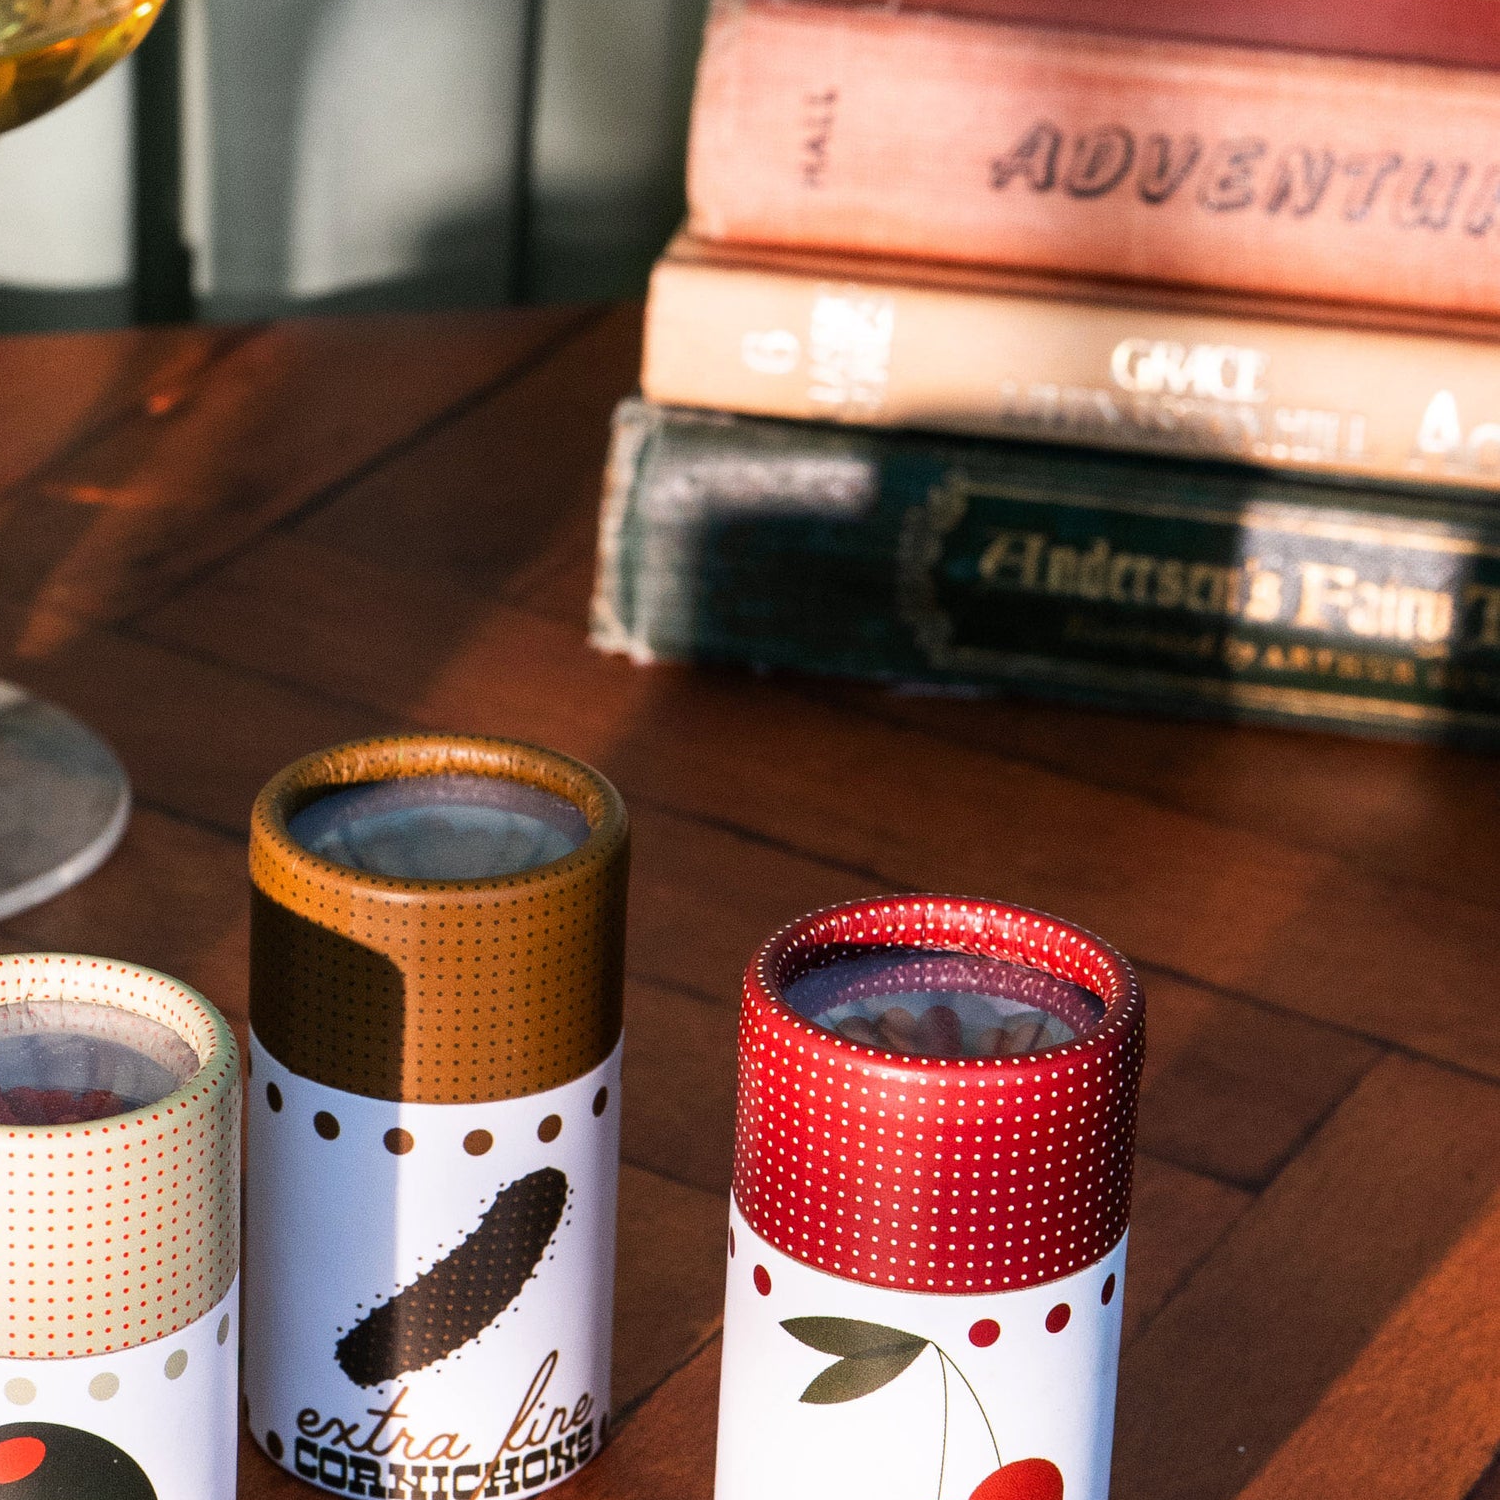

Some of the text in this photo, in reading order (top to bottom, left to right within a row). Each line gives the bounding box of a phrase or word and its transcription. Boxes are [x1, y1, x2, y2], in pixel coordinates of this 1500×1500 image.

[1109, 337, 1271, 403] GRACE
[1295, 561, 1456, 658] Fairy
[296, 1386, 472, 1461] extra
